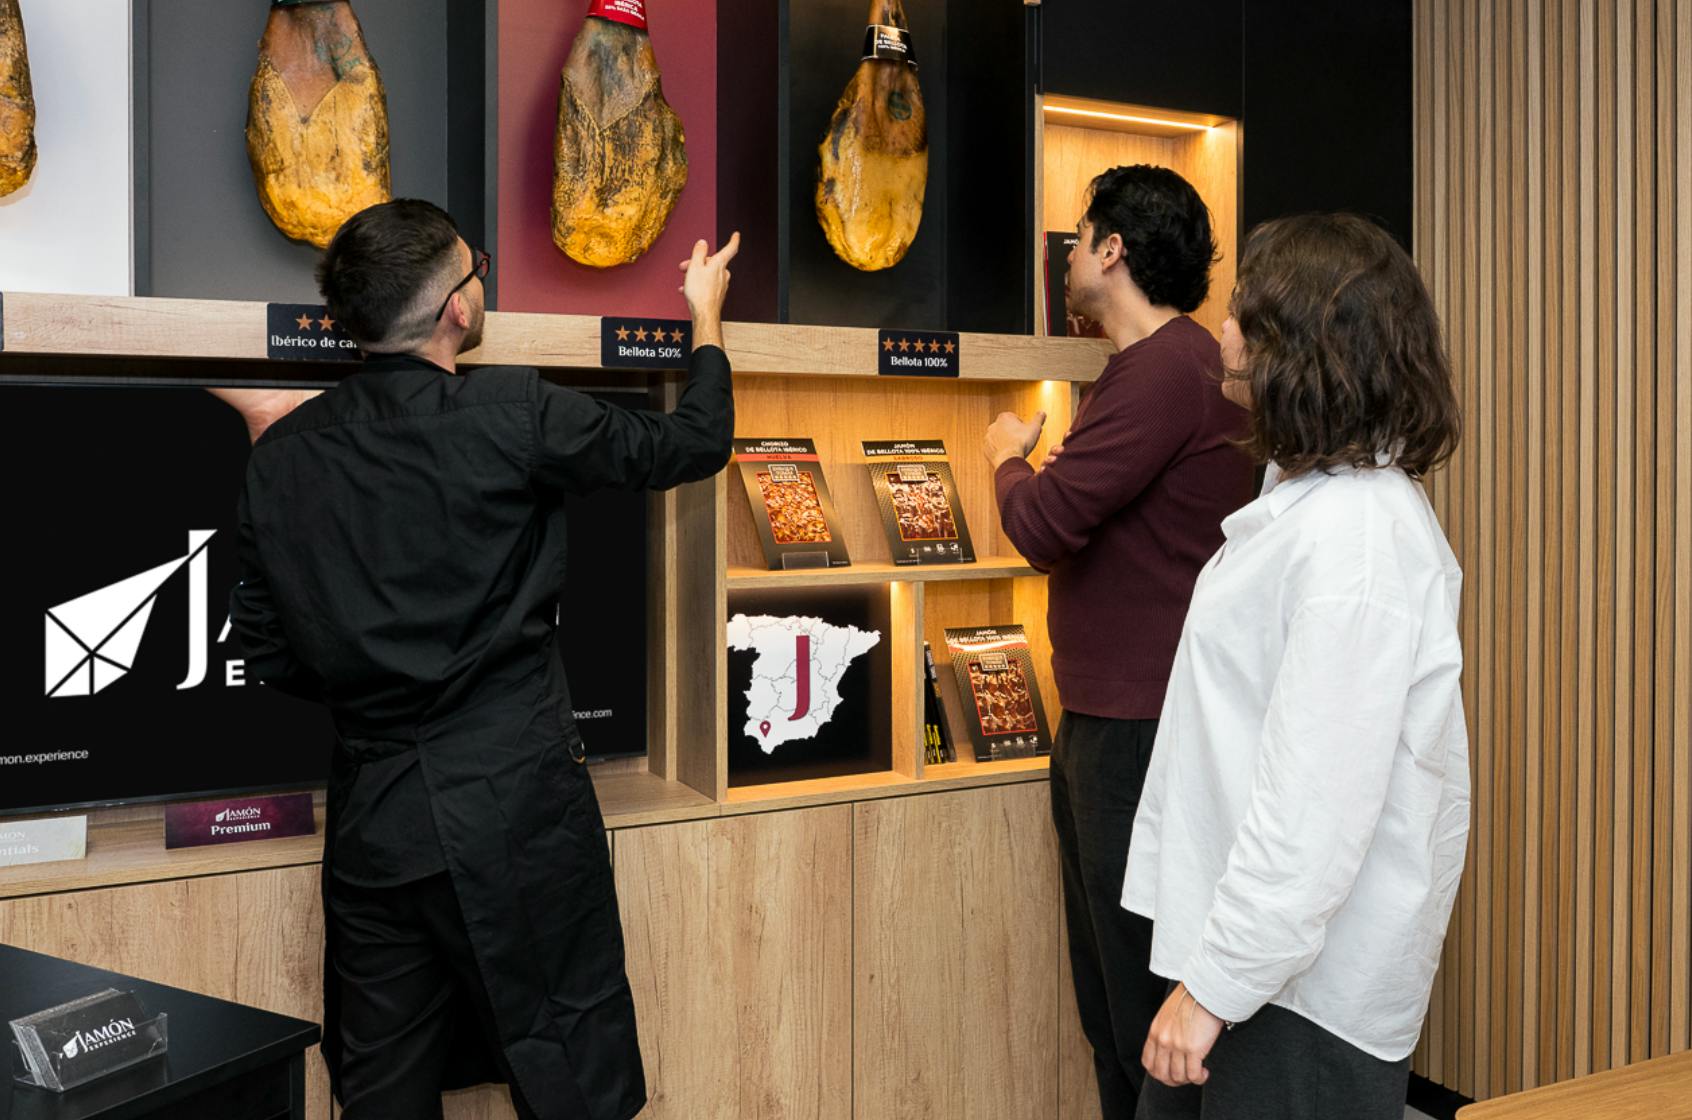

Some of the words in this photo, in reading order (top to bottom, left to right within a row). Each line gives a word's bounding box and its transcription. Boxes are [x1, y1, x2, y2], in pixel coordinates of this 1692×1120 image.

[271, 335, 317, 348] Ibérico
[320, 336, 336, 348] de
[339, 339, 358, 349] ca
[618, 345, 656, 358] Bellota
[658, 347, 682, 359] 50%
[890, 355, 922, 367] Bellota
[924, 357, 948, 368] 100%
[225, 806, 261, 821] JAMÓN
[211, 822, 271, 836] Premium
[75, 1018, 135, 1053] JAMÓN
